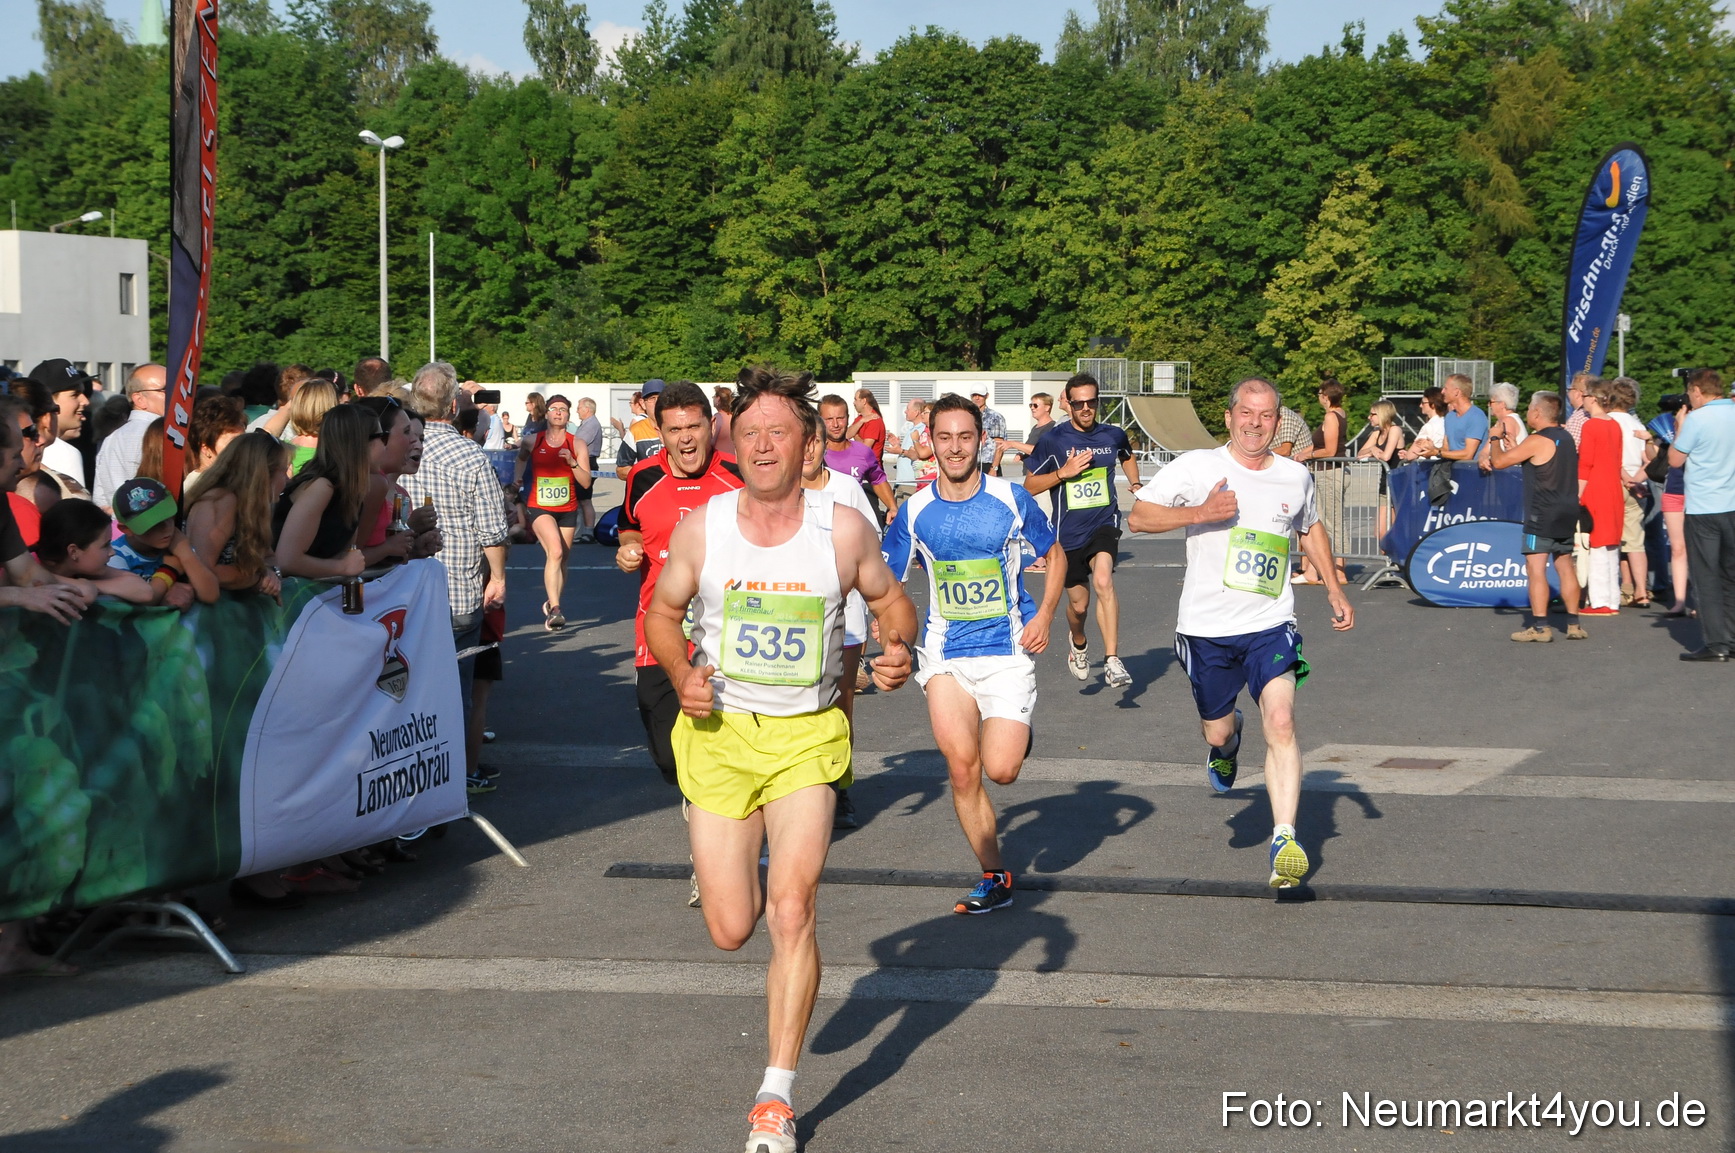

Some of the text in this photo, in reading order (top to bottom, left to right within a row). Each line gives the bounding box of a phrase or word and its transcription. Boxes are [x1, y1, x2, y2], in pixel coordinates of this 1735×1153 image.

[850, 466, 859, 476] K
[538, 487, 568, 498] 1309
[1073, 481, 1102, 498] 362
[1235, 550, 1279, 581] 886
[746, 581, 812, 593] KLEBL
[939, 579, 1002, 605] 1032
[1459, 579, 1527, 589] AUTOMOBI
[735, 623, 806, 661] 535
[368, 711, 438, 761] Neumarkter
[355, 743, 450, 818] Lammsbräu
